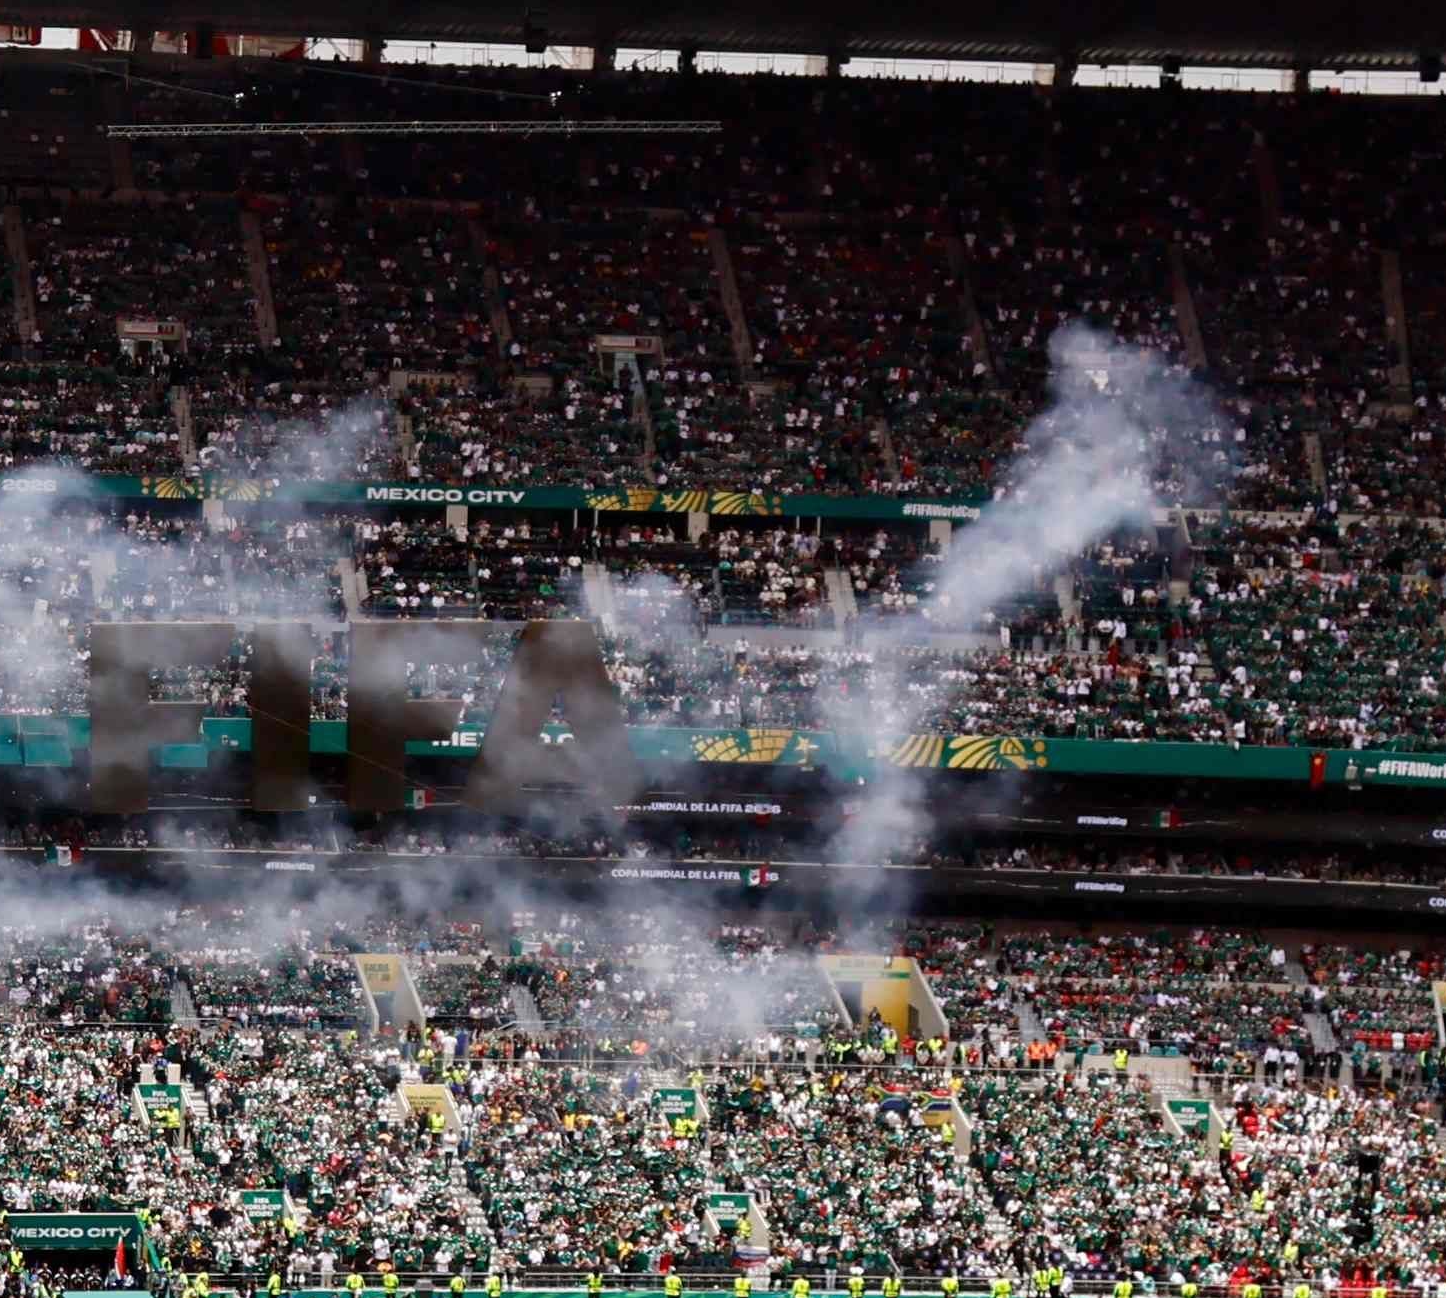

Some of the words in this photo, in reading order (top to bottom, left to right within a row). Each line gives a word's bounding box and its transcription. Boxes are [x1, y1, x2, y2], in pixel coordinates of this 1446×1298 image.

[366, 487, 463, 502] MEXICO
[467, 490, 526, 503] CITY
[721, 804, 743, 813] FIFA
[12, 1226, 84, 1239] MEXICO
[87, 1226, 132, 1239] CITY
